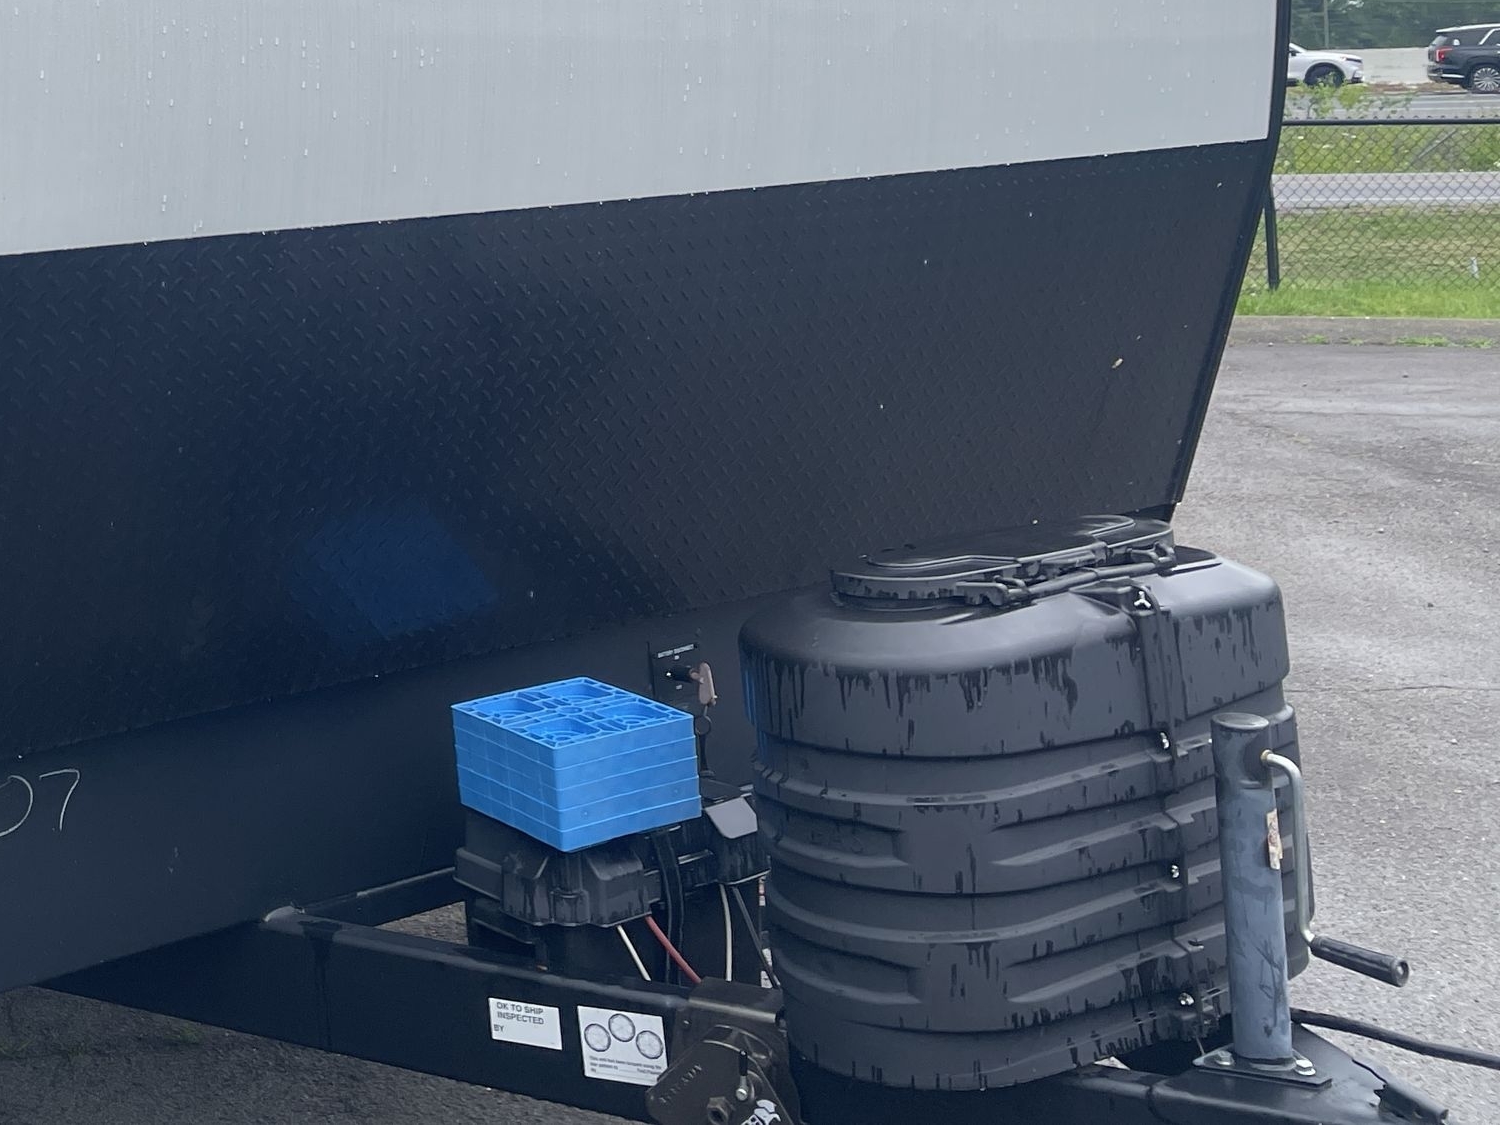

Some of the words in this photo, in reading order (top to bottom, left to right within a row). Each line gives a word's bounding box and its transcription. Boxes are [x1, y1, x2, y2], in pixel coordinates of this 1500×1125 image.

[496, 1001, 509, 1011] OK
[511, 1003, 523, 1013] TO
[524, 1006, 544, 1015] SHIP
[497, 1011, 545, 1025] INSPECTED
[493, 1024, 505, 1033] BY
